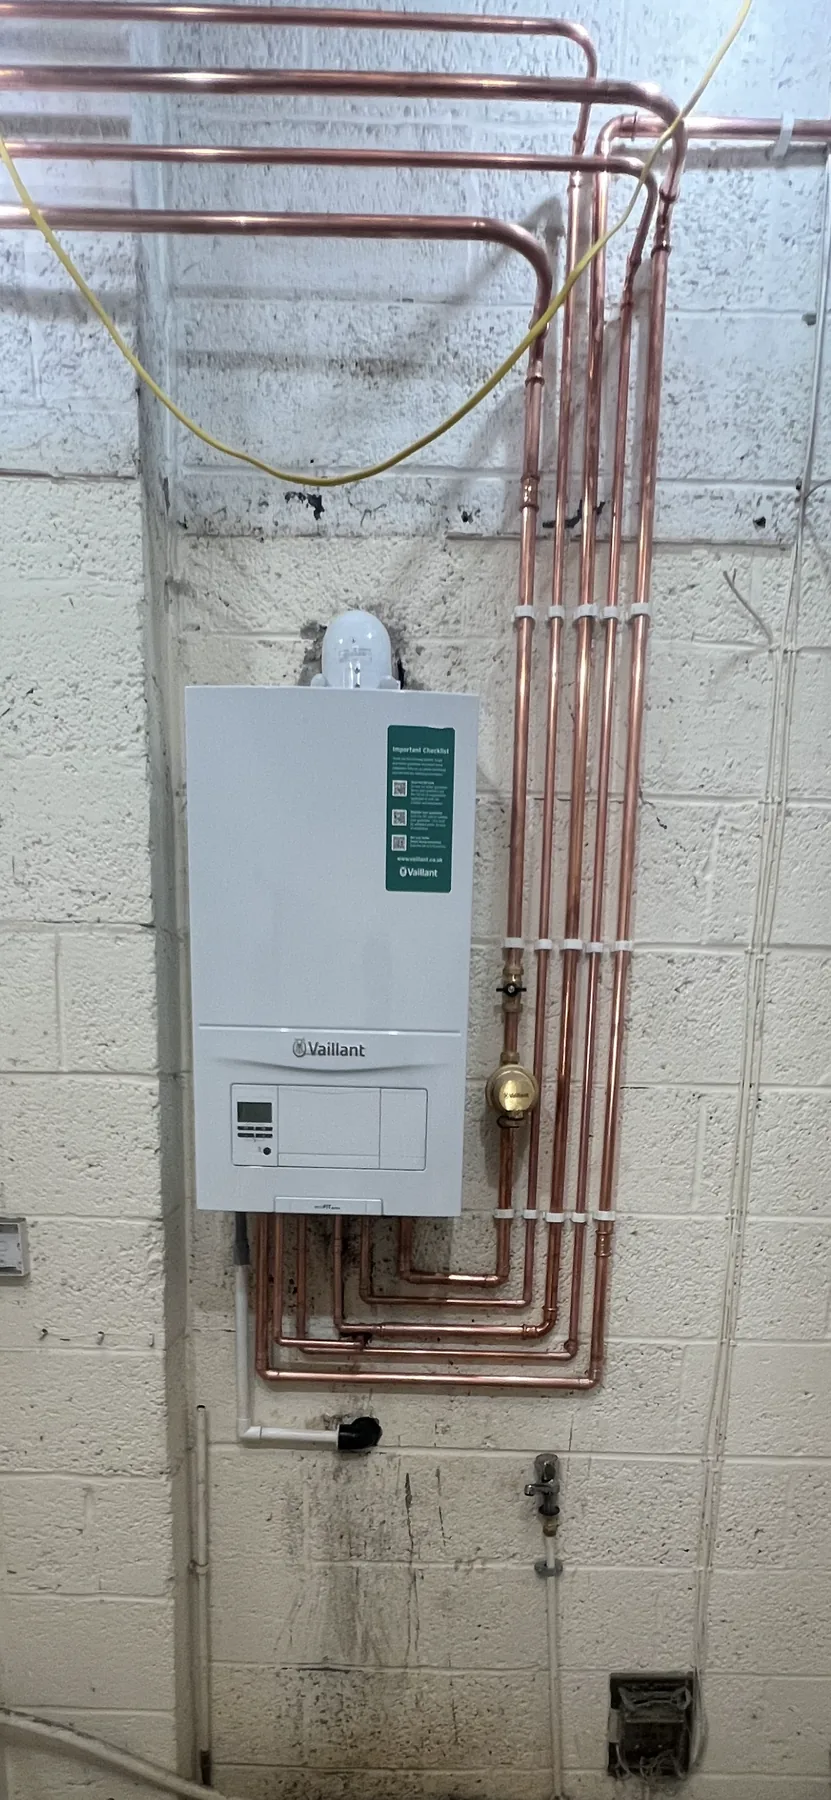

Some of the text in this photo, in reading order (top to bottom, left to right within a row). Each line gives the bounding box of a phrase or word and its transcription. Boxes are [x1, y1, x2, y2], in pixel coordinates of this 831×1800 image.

[392, 746, 450, 755] Important Checklist
[407, 867, 438, 878] Vaillant
[307, 1041, 366, 1057] Vaillant
